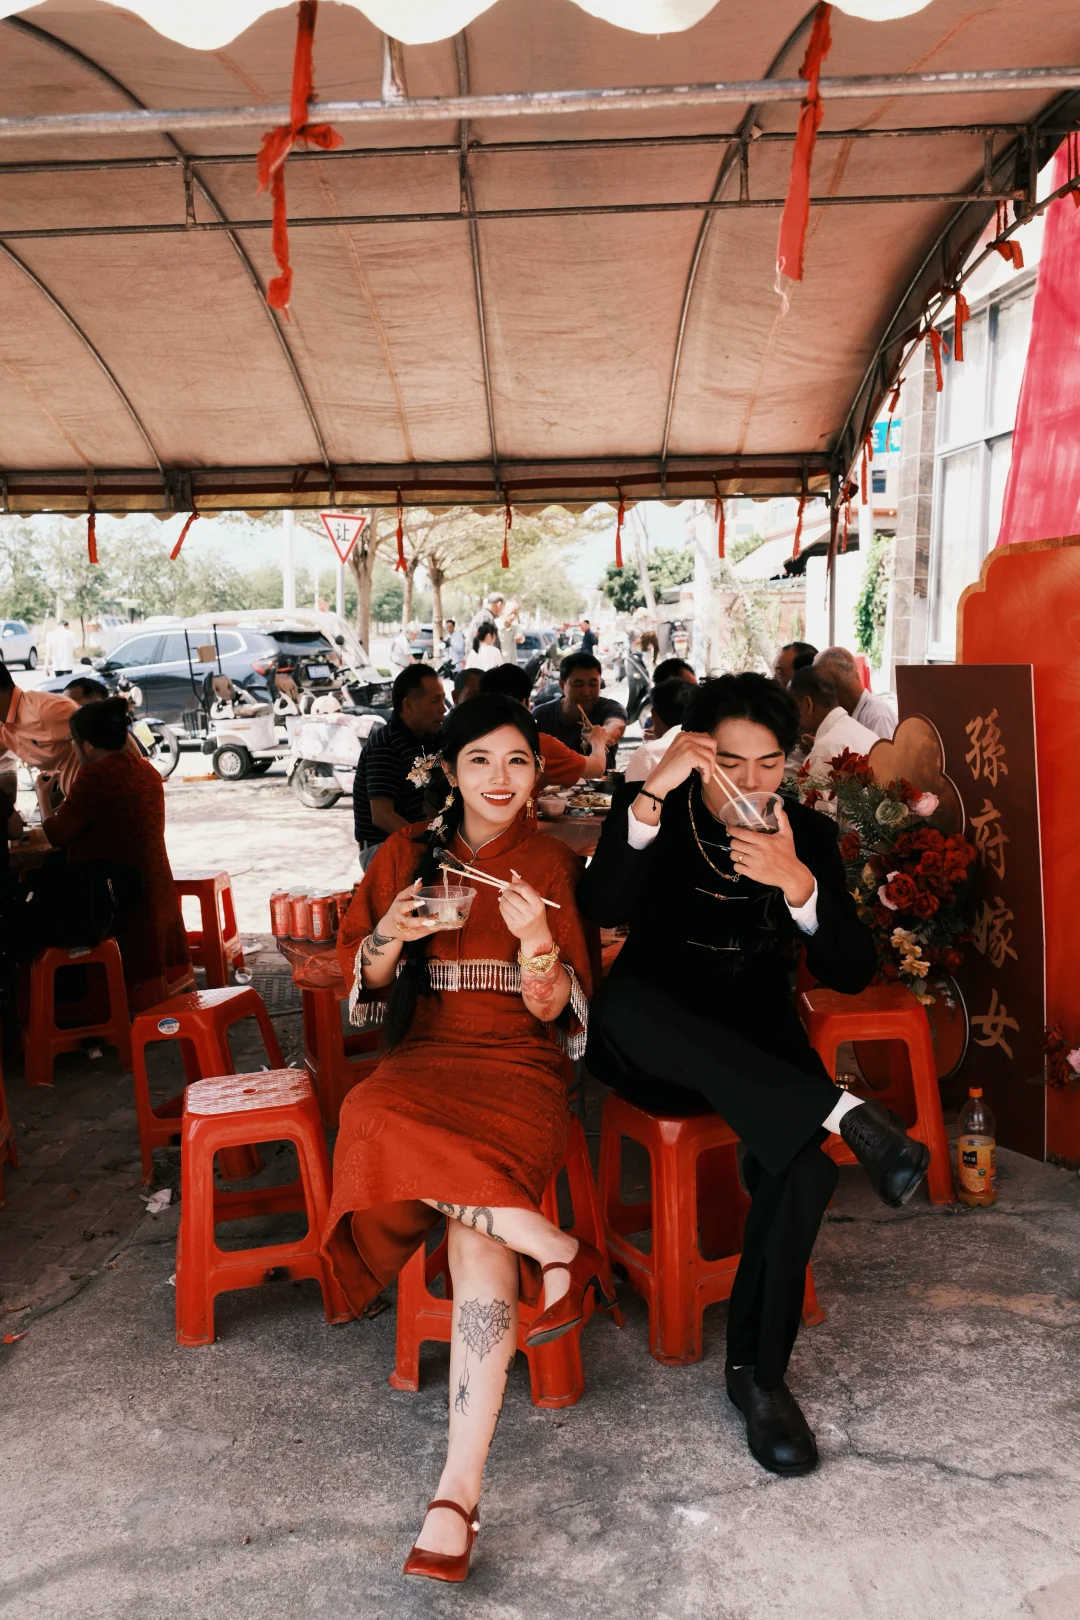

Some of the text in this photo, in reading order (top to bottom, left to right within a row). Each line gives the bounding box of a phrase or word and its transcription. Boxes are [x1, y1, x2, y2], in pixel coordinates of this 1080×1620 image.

[335, 522, 350, 541] 让
[965, 708, 1020, 1060] 孫府嫁女
